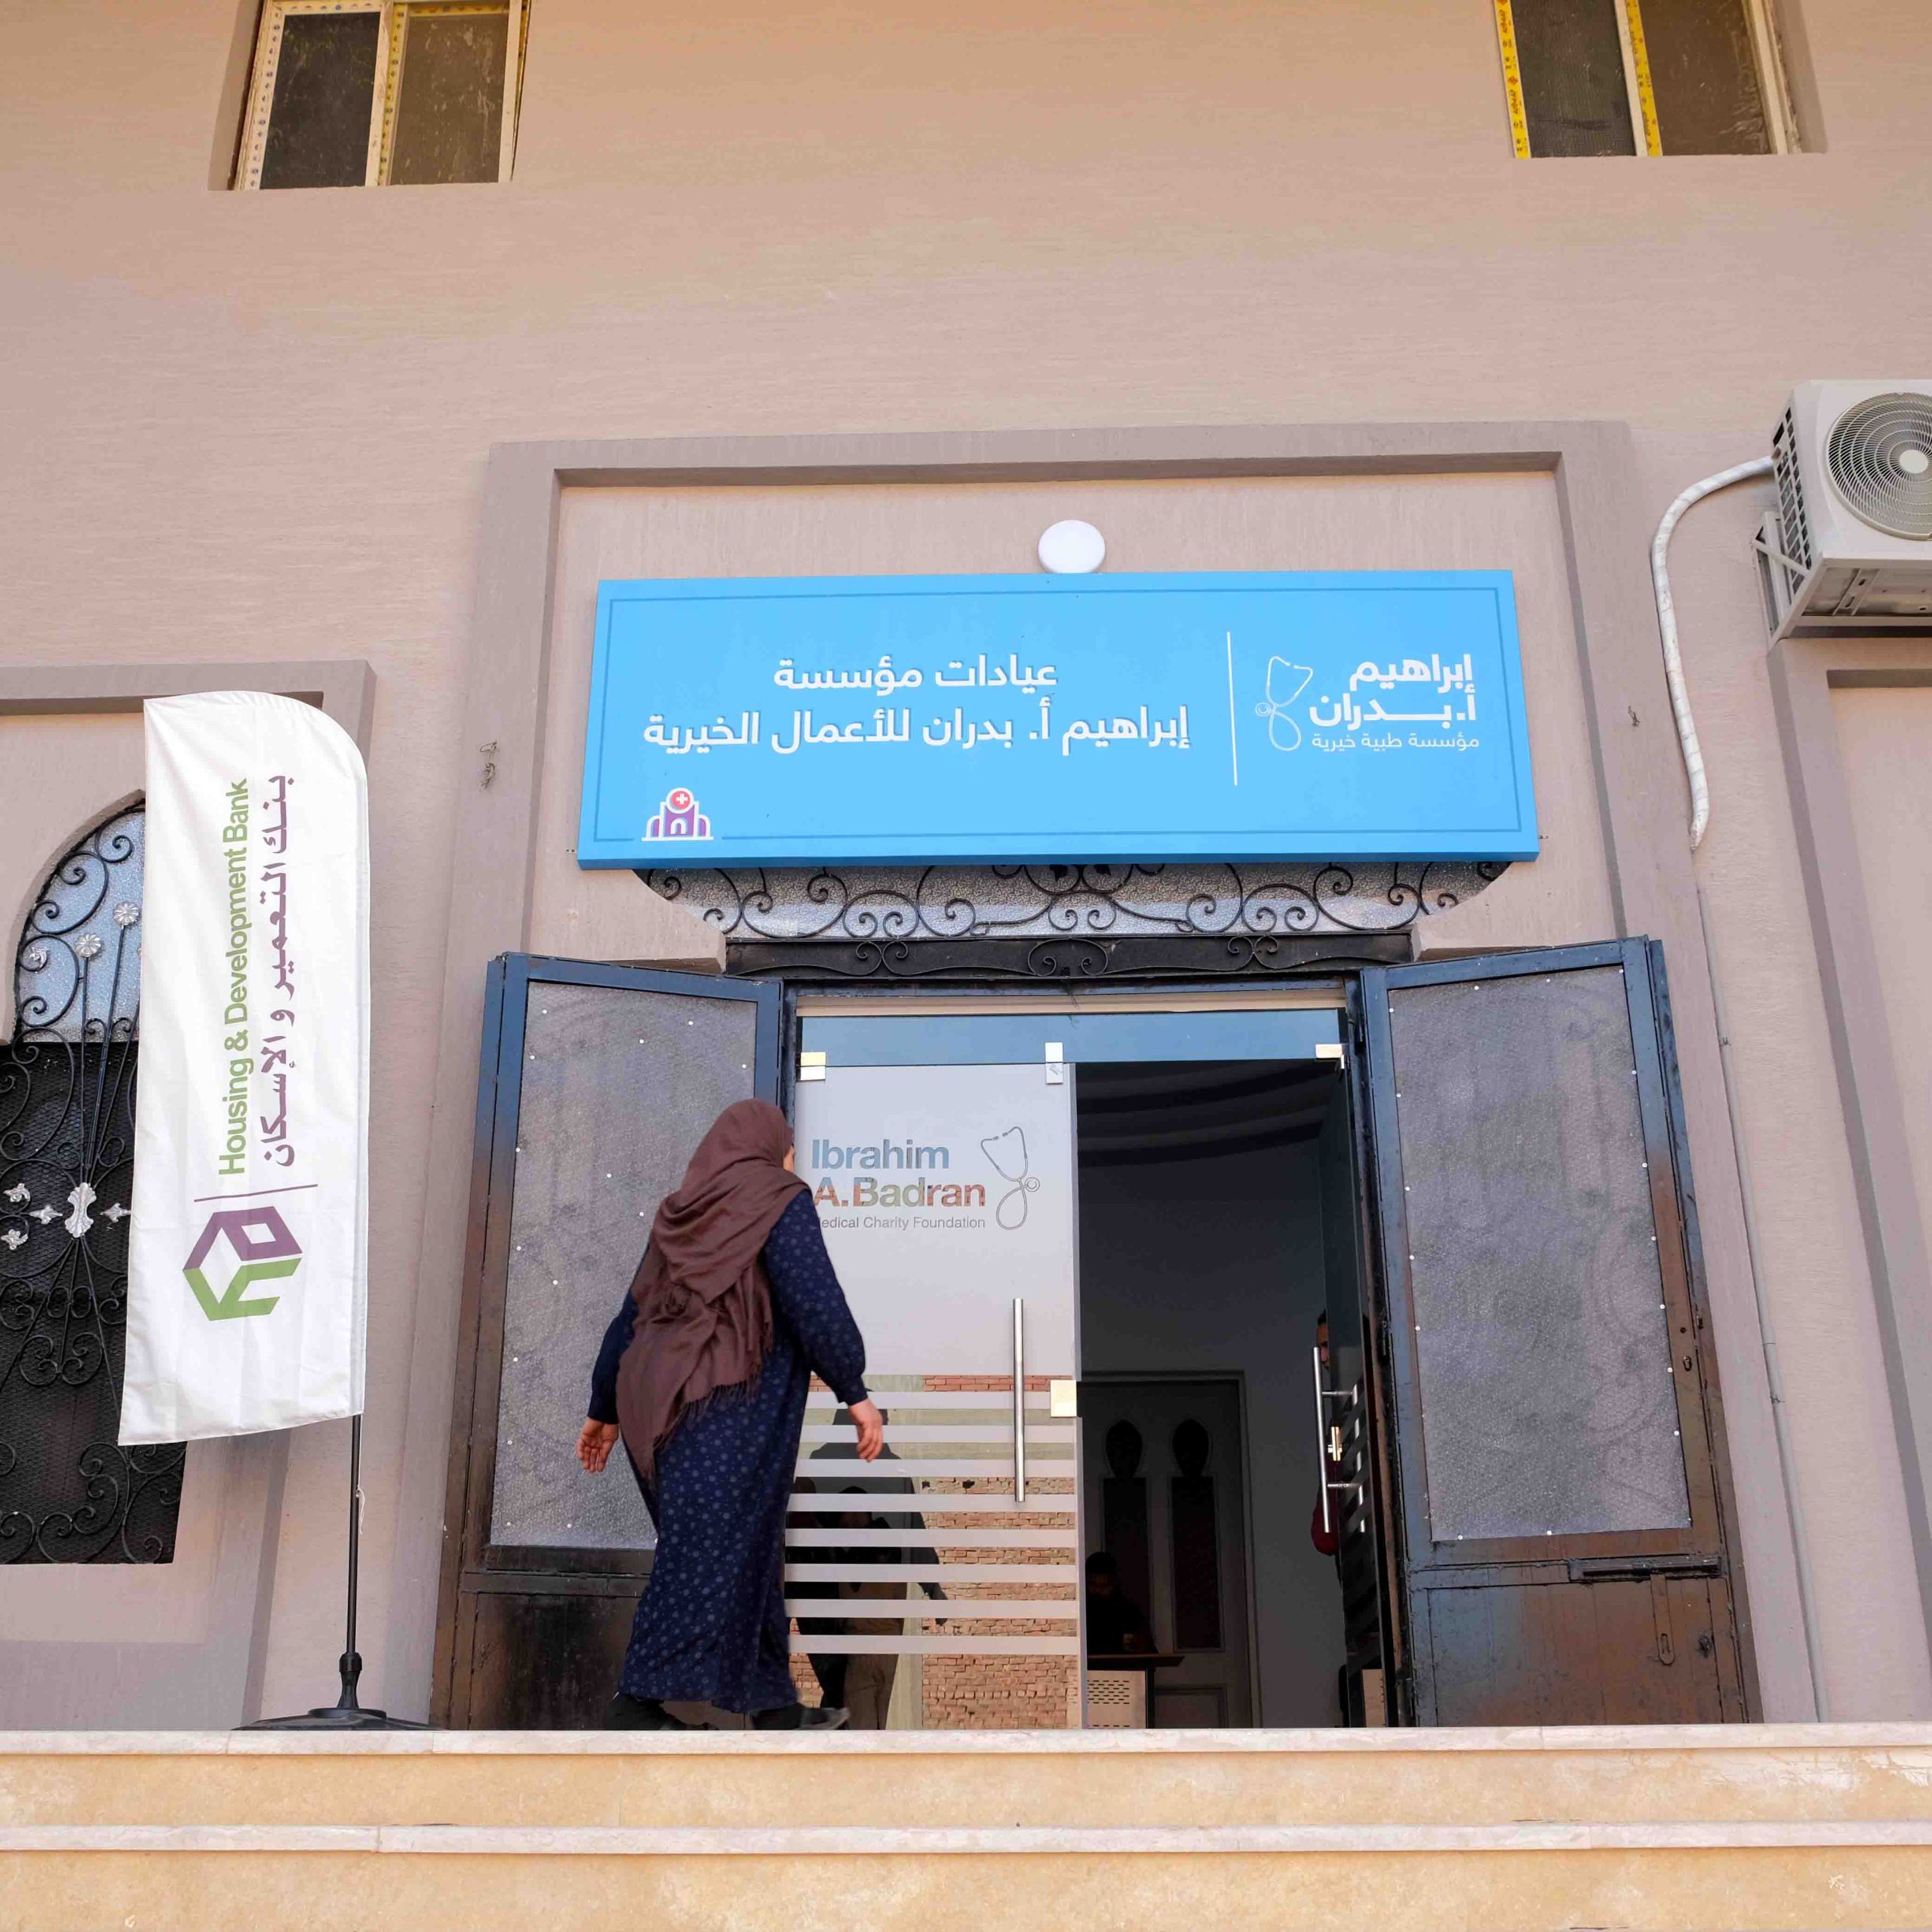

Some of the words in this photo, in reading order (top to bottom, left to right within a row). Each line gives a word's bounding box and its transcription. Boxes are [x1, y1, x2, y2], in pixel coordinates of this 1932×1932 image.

[774, 656, 922, 697] مؤسسة
[935, 654, 1057, 694] عيادات
[644, 712, 759, 754] الخيرية
[771, 709, 909, 754] للأعمال
[922, 708, 1012, 749] بدران
[1029, 697, 1051, 740] أ.
[1062, 706, 1189, 756] إبراهيم
[1312, 734, 1356, 752] خيرية
[1361, 732, 1402, 752] طبية
[1408, 732, 1480, 752] مؤسسة
[223, 777, 248, 843] Bank
[261, 775, 294, 854] بنك
[223, 847, 253, 1025] Development
[260, 862, 295, 1001] التعمير
[224, 1029, 248, 1051] &
[218, 1057, 254, 1175] Housing
[811, 1139, 949, 1170] Ibrahim
[814, 1177, 986, 1208] A.Badran
[820, 1217, 859, 1229] edical
[863, 1217, 909, 1231] Charity
[912, 1217, 986, 1229] Foundation
